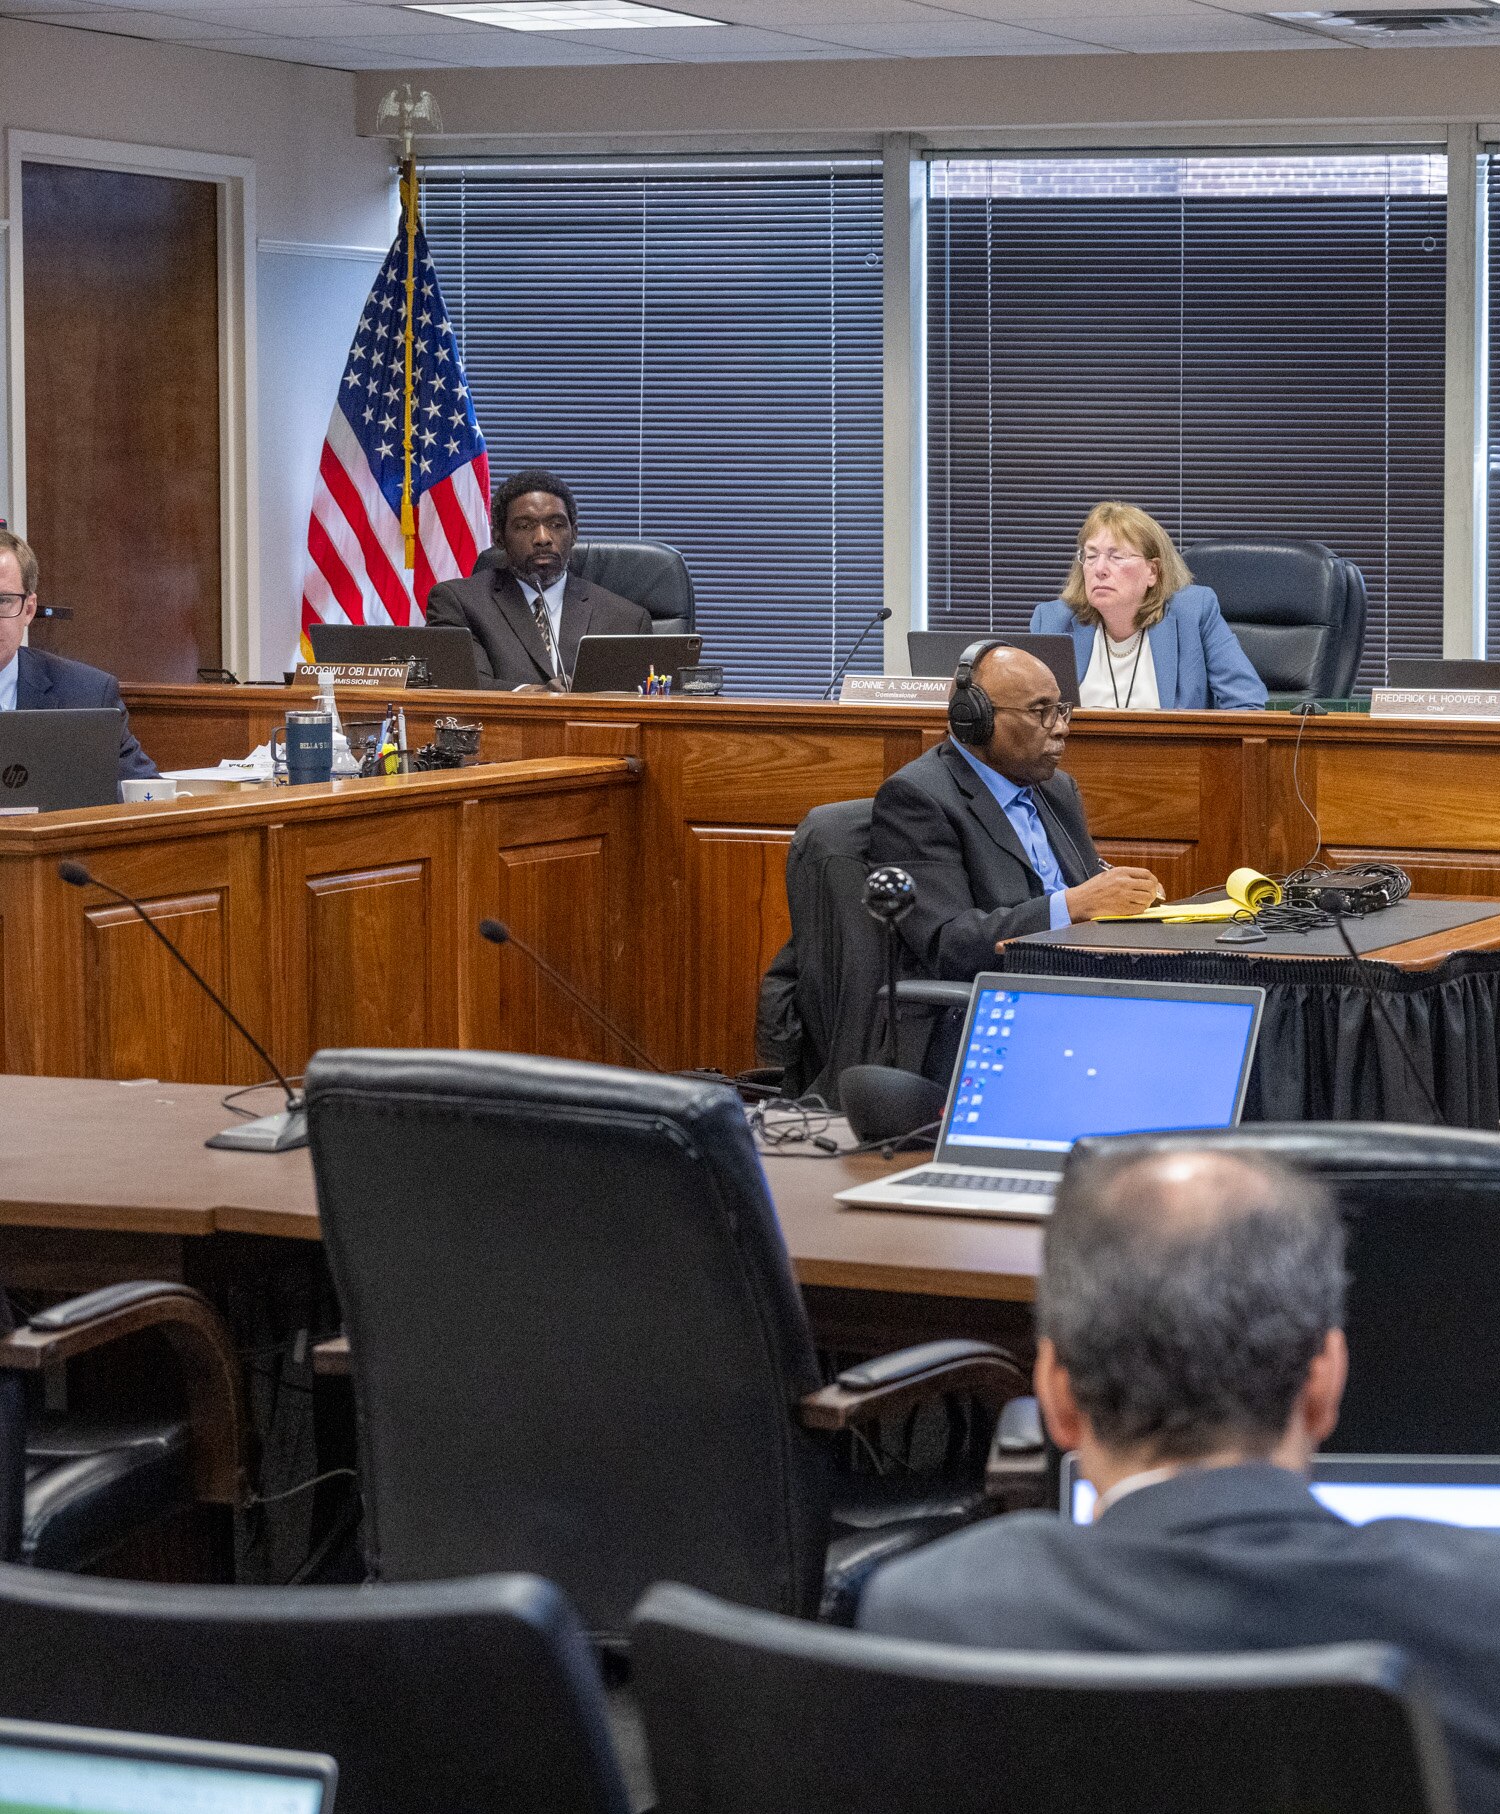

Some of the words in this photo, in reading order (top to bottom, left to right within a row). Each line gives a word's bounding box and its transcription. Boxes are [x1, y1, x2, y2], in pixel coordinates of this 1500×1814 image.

[301, 665, 346, 676] ODOGWU
[348, 667, 365, 677] OBI
[367, 668, 404, 678] LINTON
[333, 678, 380, 686] MMISSIONER
[851, 680, 885, 690] BONNIE
[888, 681, 898, 690] A.
[900, 682, 947, 692] SUCHMAN
[874, 691, 918, 699] Commissioner
[1375, 693, 1425, 703] FREDERICK
[1428, 694, 1437, 703] H.
[1440, 694, 1482, 705] HOOVER,
[1485, 695, 1499, 704] JR.
